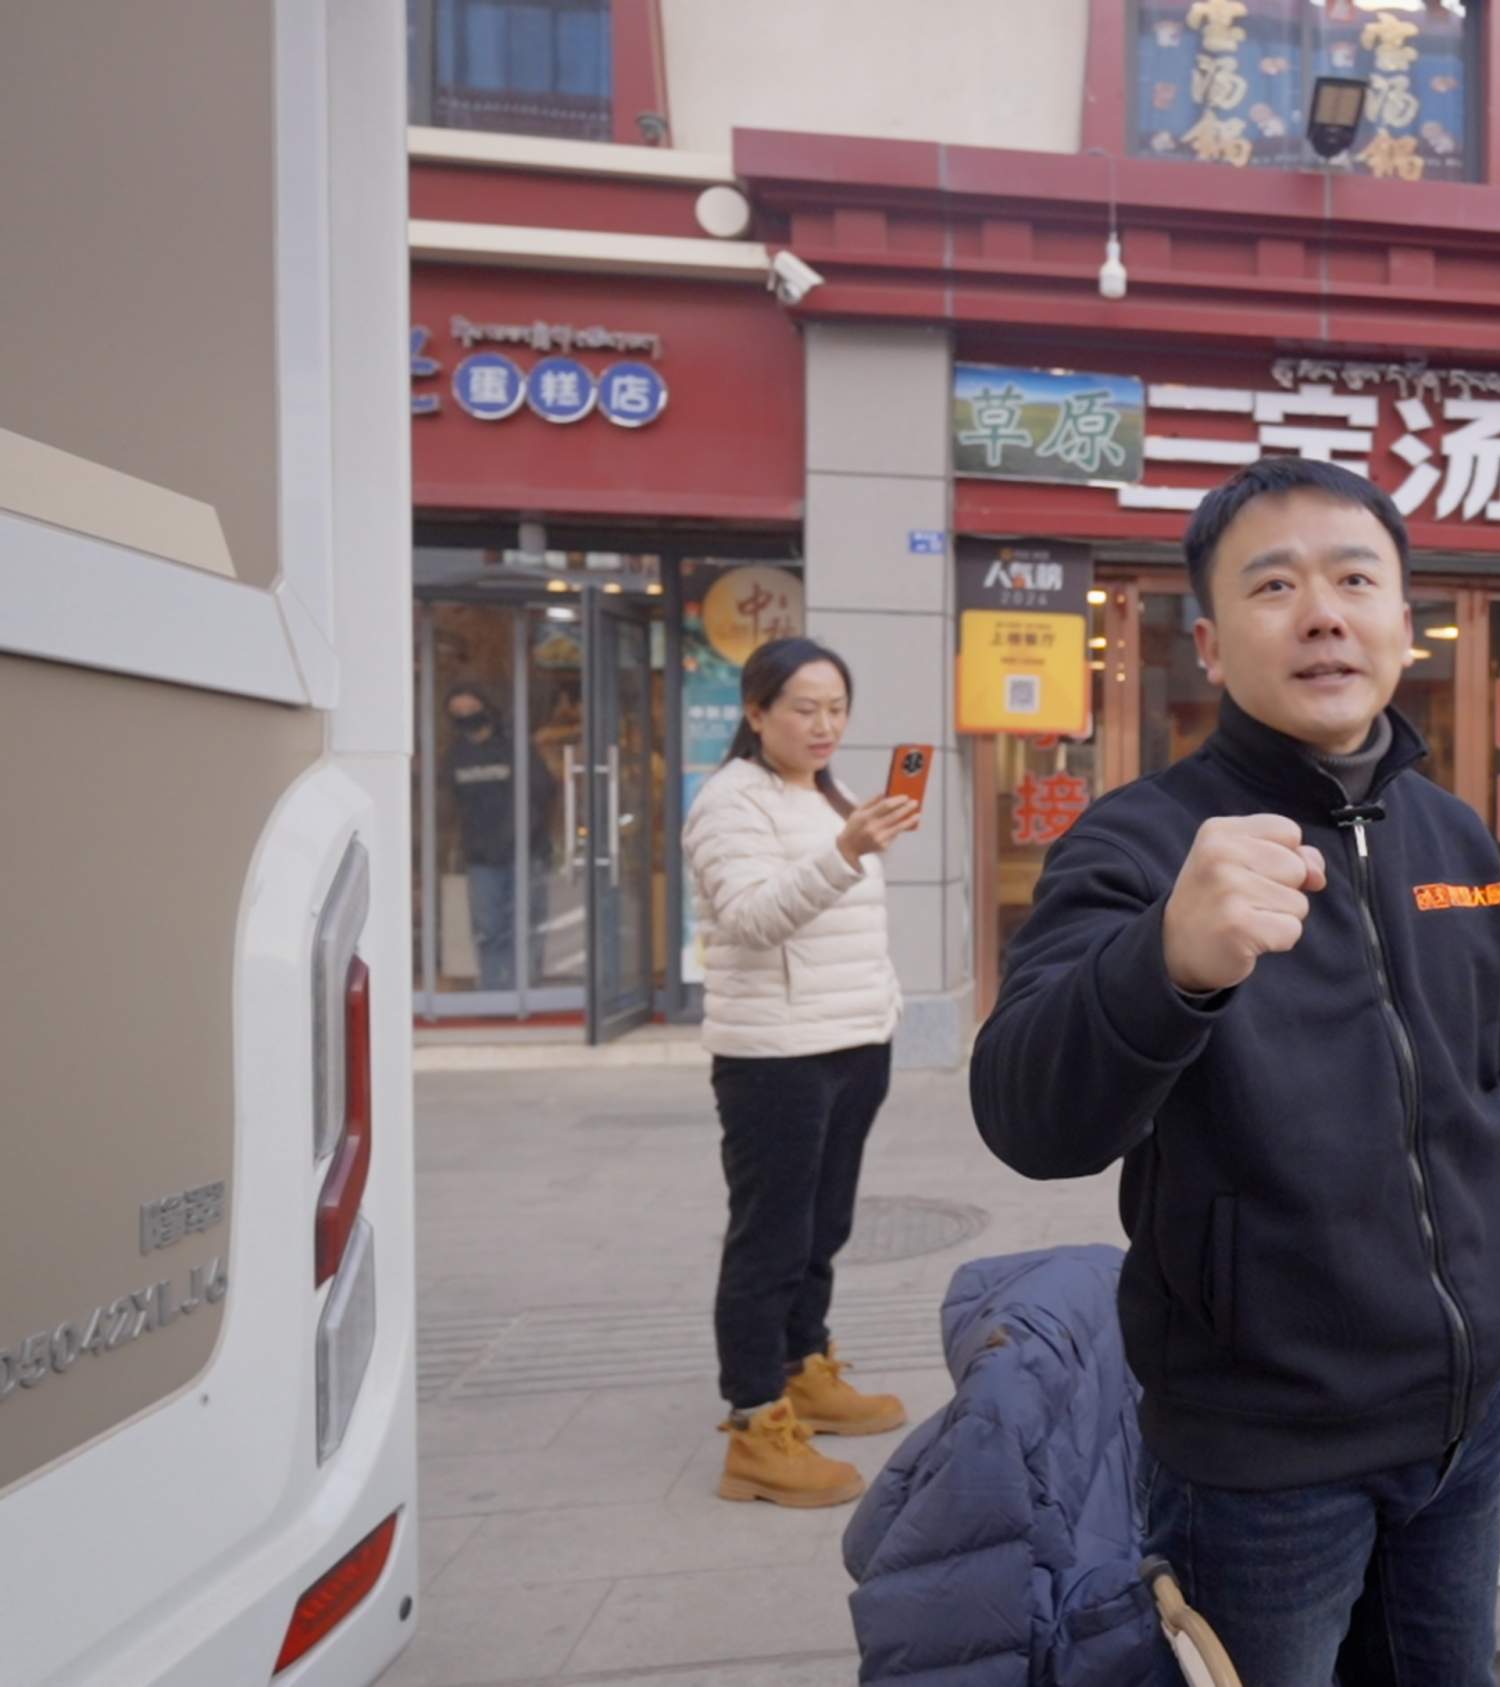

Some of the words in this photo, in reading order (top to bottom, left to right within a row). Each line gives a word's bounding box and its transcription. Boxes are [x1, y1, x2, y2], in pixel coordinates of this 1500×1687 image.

[467, 364, 653, 415] 蛋糕店
[956, 382, 1128, 473] 草原
